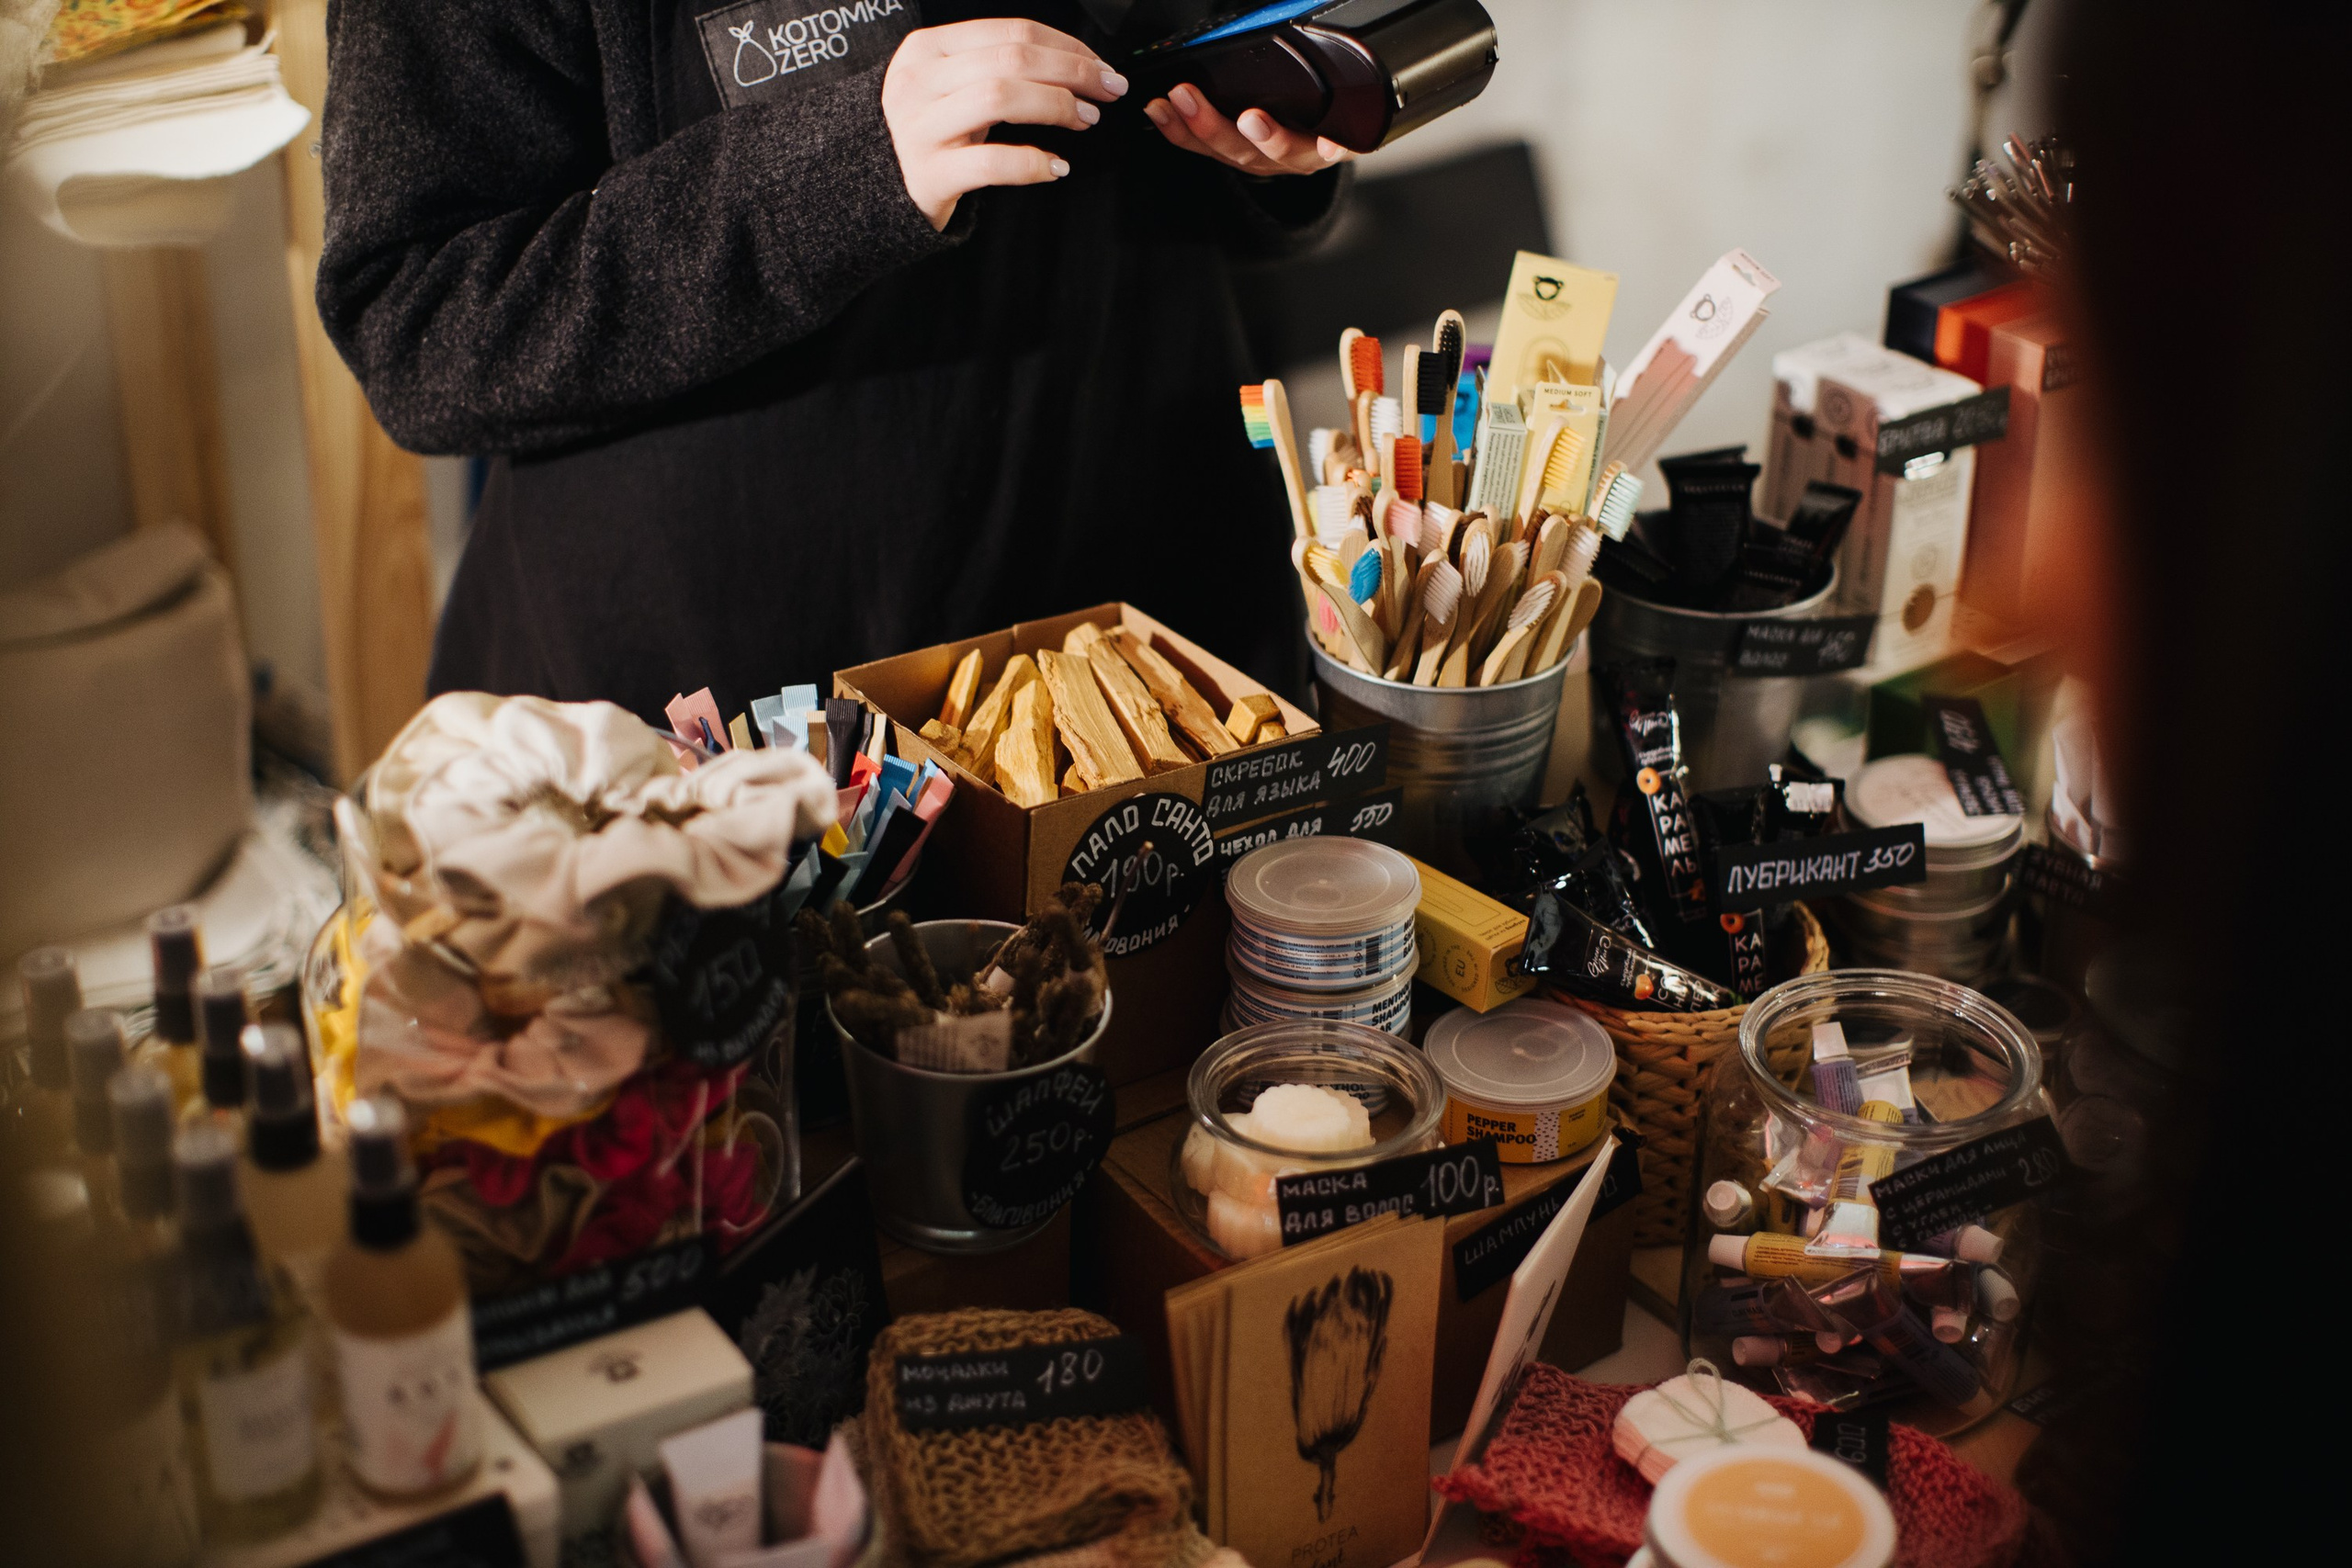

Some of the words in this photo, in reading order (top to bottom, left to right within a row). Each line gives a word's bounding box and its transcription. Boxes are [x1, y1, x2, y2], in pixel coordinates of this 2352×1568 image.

[768, 0, 903, 51] KOTOMKA
[775, 33, 848, 74] ZERO
[1211, 750, 1303, 788] СКРЕБОК
[1328, 741, 1376, 778] 400
[1206, 790, 1246, 818] ДЛЯ
[1253, 770, 1321, 806] ЯЗЫКА
[1220, 829, 1277, 856] ЧЕХОЛ
[1285, 817, 1322, 839] ДЛЯ
[1350, 802, 1393, 832] 550
[1071, 805, 1139, 879] ПАЛО
[1151, 798, 1215, 866] САНТО
[1727, 851, 1862, 894] ЛУБРИКАНТ
[1863, 841, 1915, 873] 350
[1455, 959, 1466, 978] EU
[986, 1067, 1106, 1137] ШАЛФЕЙ
[1467, 1113, 1517, 1133] PEPPER
[1467, 1126, 1537, 1145] SHAMPOO
[1283, 1171, 1368, 1198] МАСКА
[1874, 1165, 1940, 1198] МАСКИ
[1944, 1148, 1978, 1173] ДЛЯ
[2018, 1146, 2062, 1188] 280
[1284, 1211, 1334, 1235] ДЛЯ
[1346, 1194, 1413, 1224] ВОЛОС
[1464, 1194, 1560, 1265] ШАМПУНЬ
[902, 1360, 1009, 1383] МОЧАЛКИ
[1037, 1348, 1103, 1394] 180
[904, 1394, 937, 1416] ИЗ
[947, 1389, 1026, 1414] ДЖУТА
[1292, 1526, 1359, 1563] PROTEA
